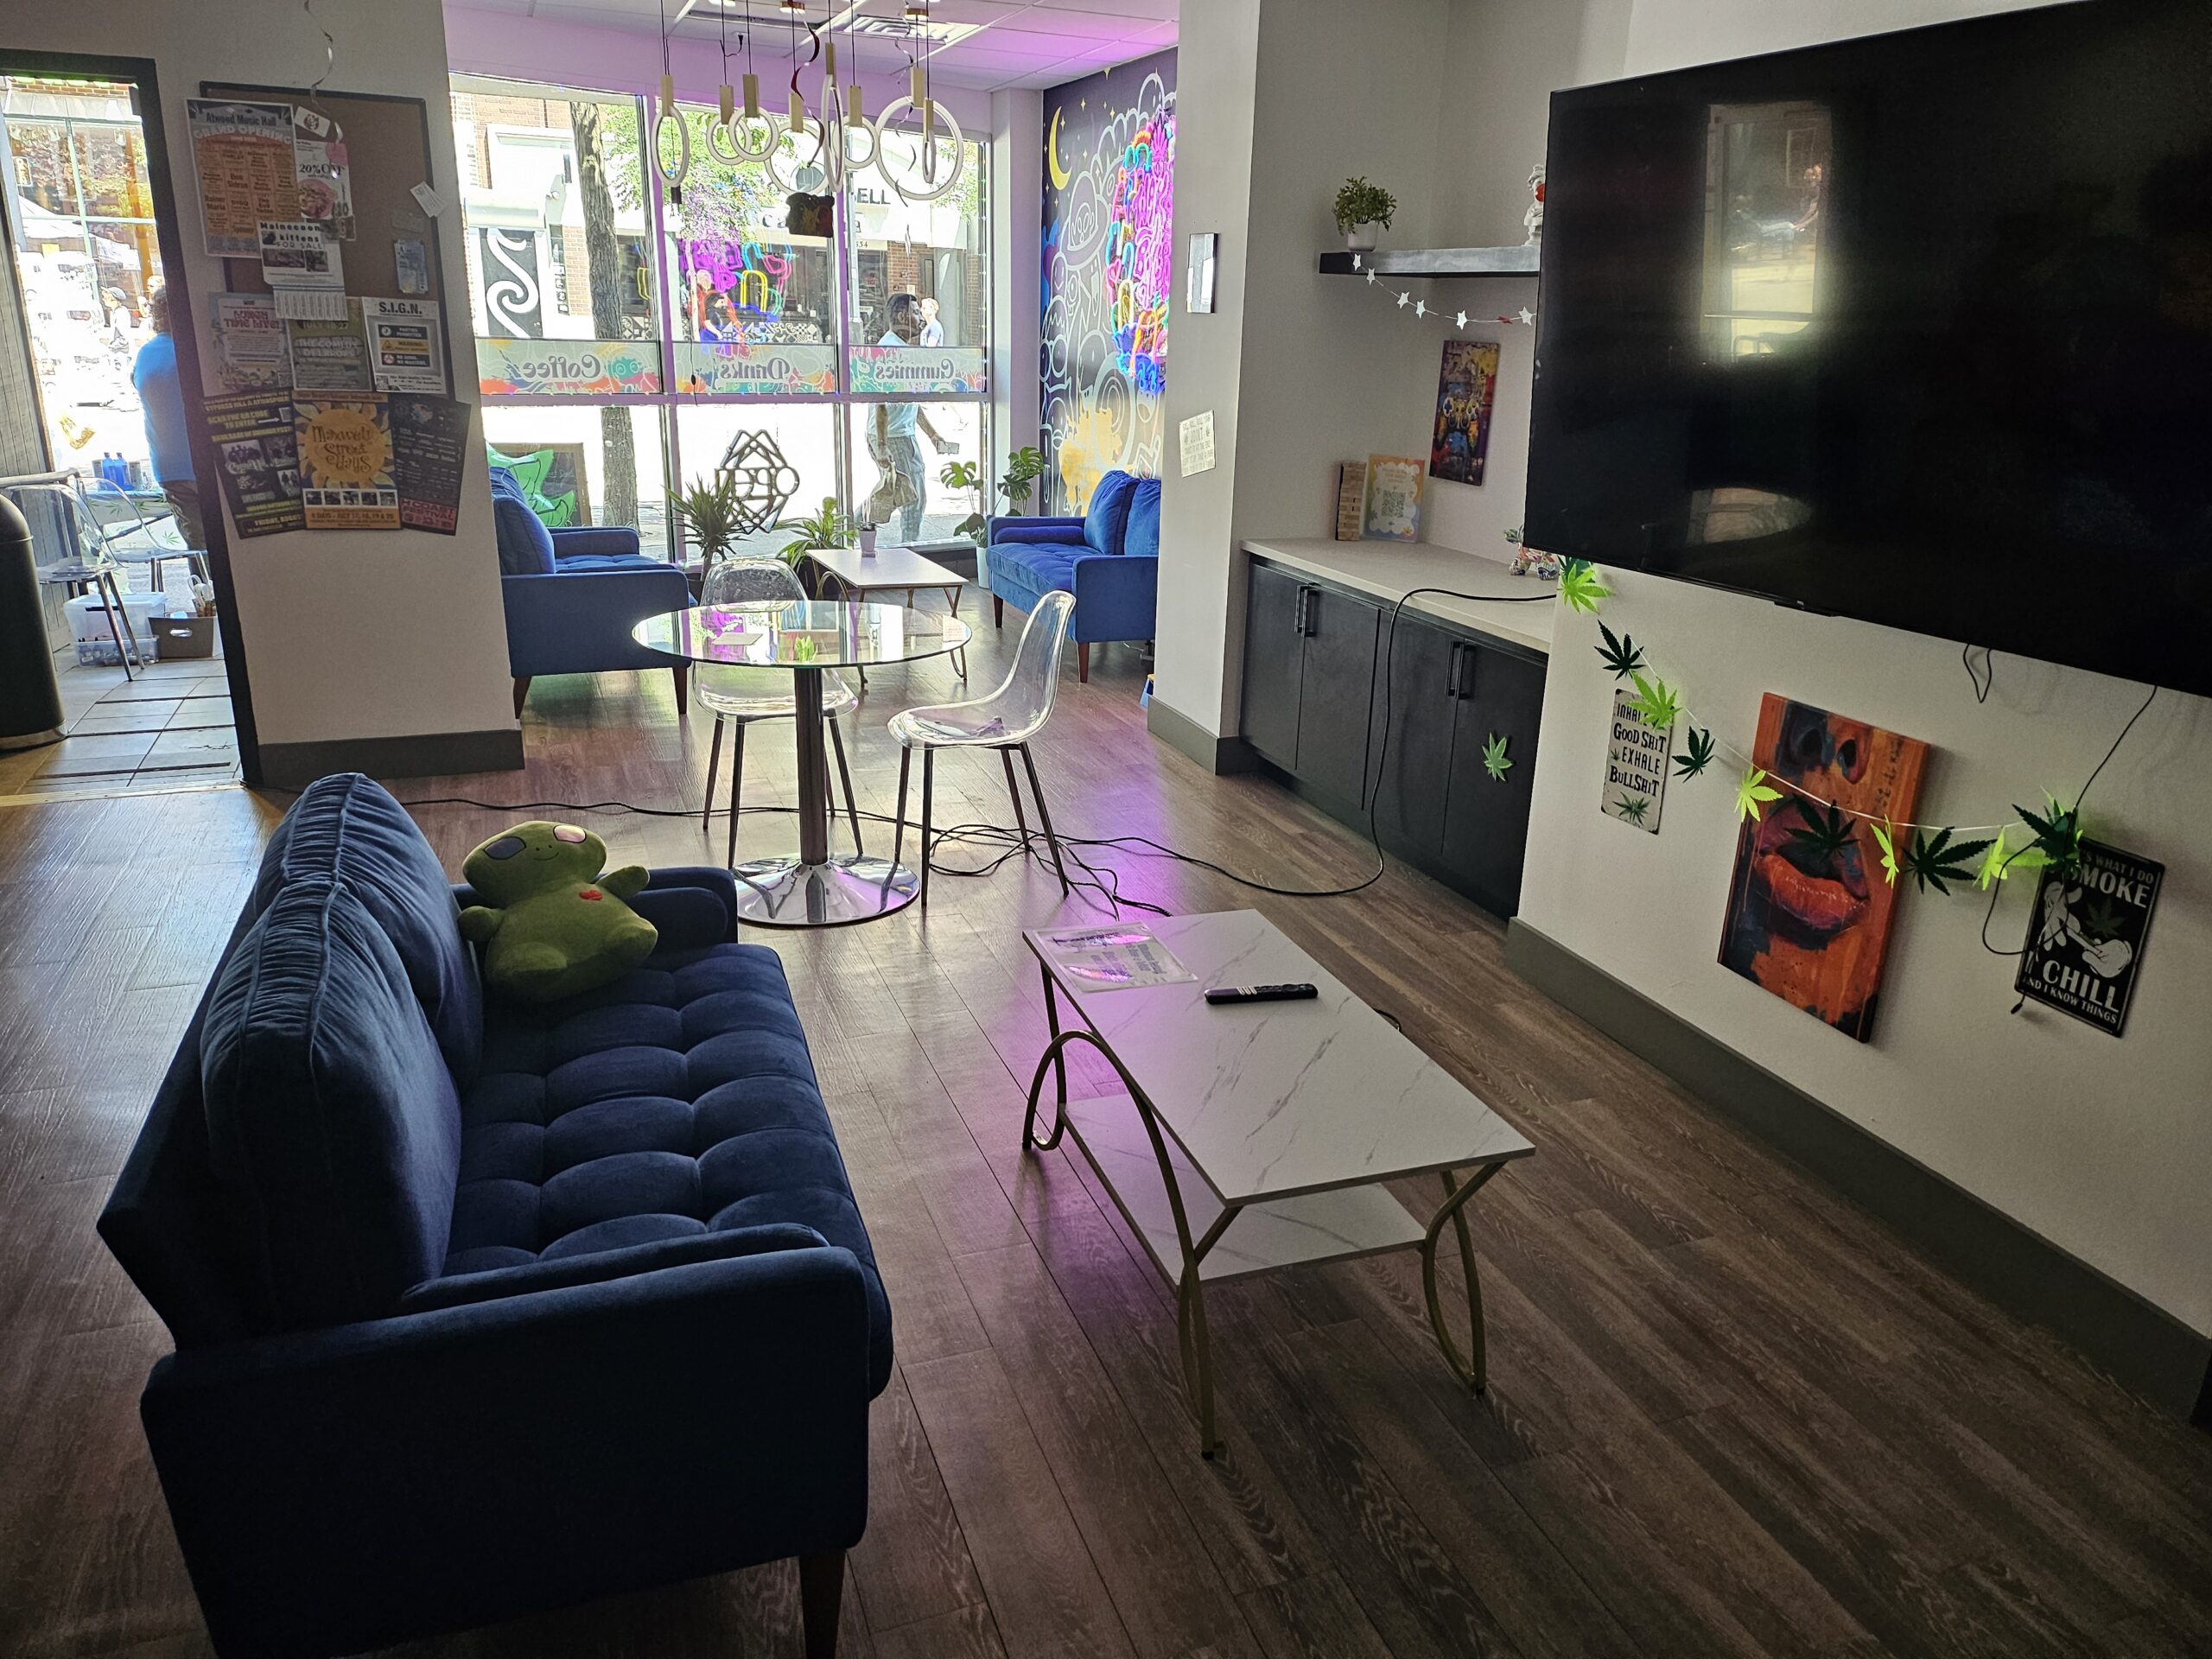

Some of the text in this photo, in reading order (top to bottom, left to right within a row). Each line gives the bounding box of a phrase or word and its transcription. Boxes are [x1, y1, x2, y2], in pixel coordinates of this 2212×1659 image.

[206, 112, 276, 126] Atwood Music Hall
[193, 125, 235, 139] GRAND
[238, 125, 292, 145] OPENING
[299, 164, 320, 175] 20%
[855, 188, 891, 204] ELL
[279, 233, 320, 242] kittens
[378, 302, 423, 315] S.I.G.N.
[312, 424, 374, 442] Maxwell
[324, 442, 368, 461] Street
[412, 500, 455, 515] COAST
[1621, 746, 1661, 775] EXHALE
[2095, 853, 2126, 874] WHAT
[2129, 867, 2135, 877] I
[2137, 869, 2154, 885] DO
[2043, 959, 2119, 1014] CHILL
[2044, 983, 2048, 993] I
[2050, 984, 2080, 1007] KNOW
[2082, 999, 2118, 1025] THINGS
